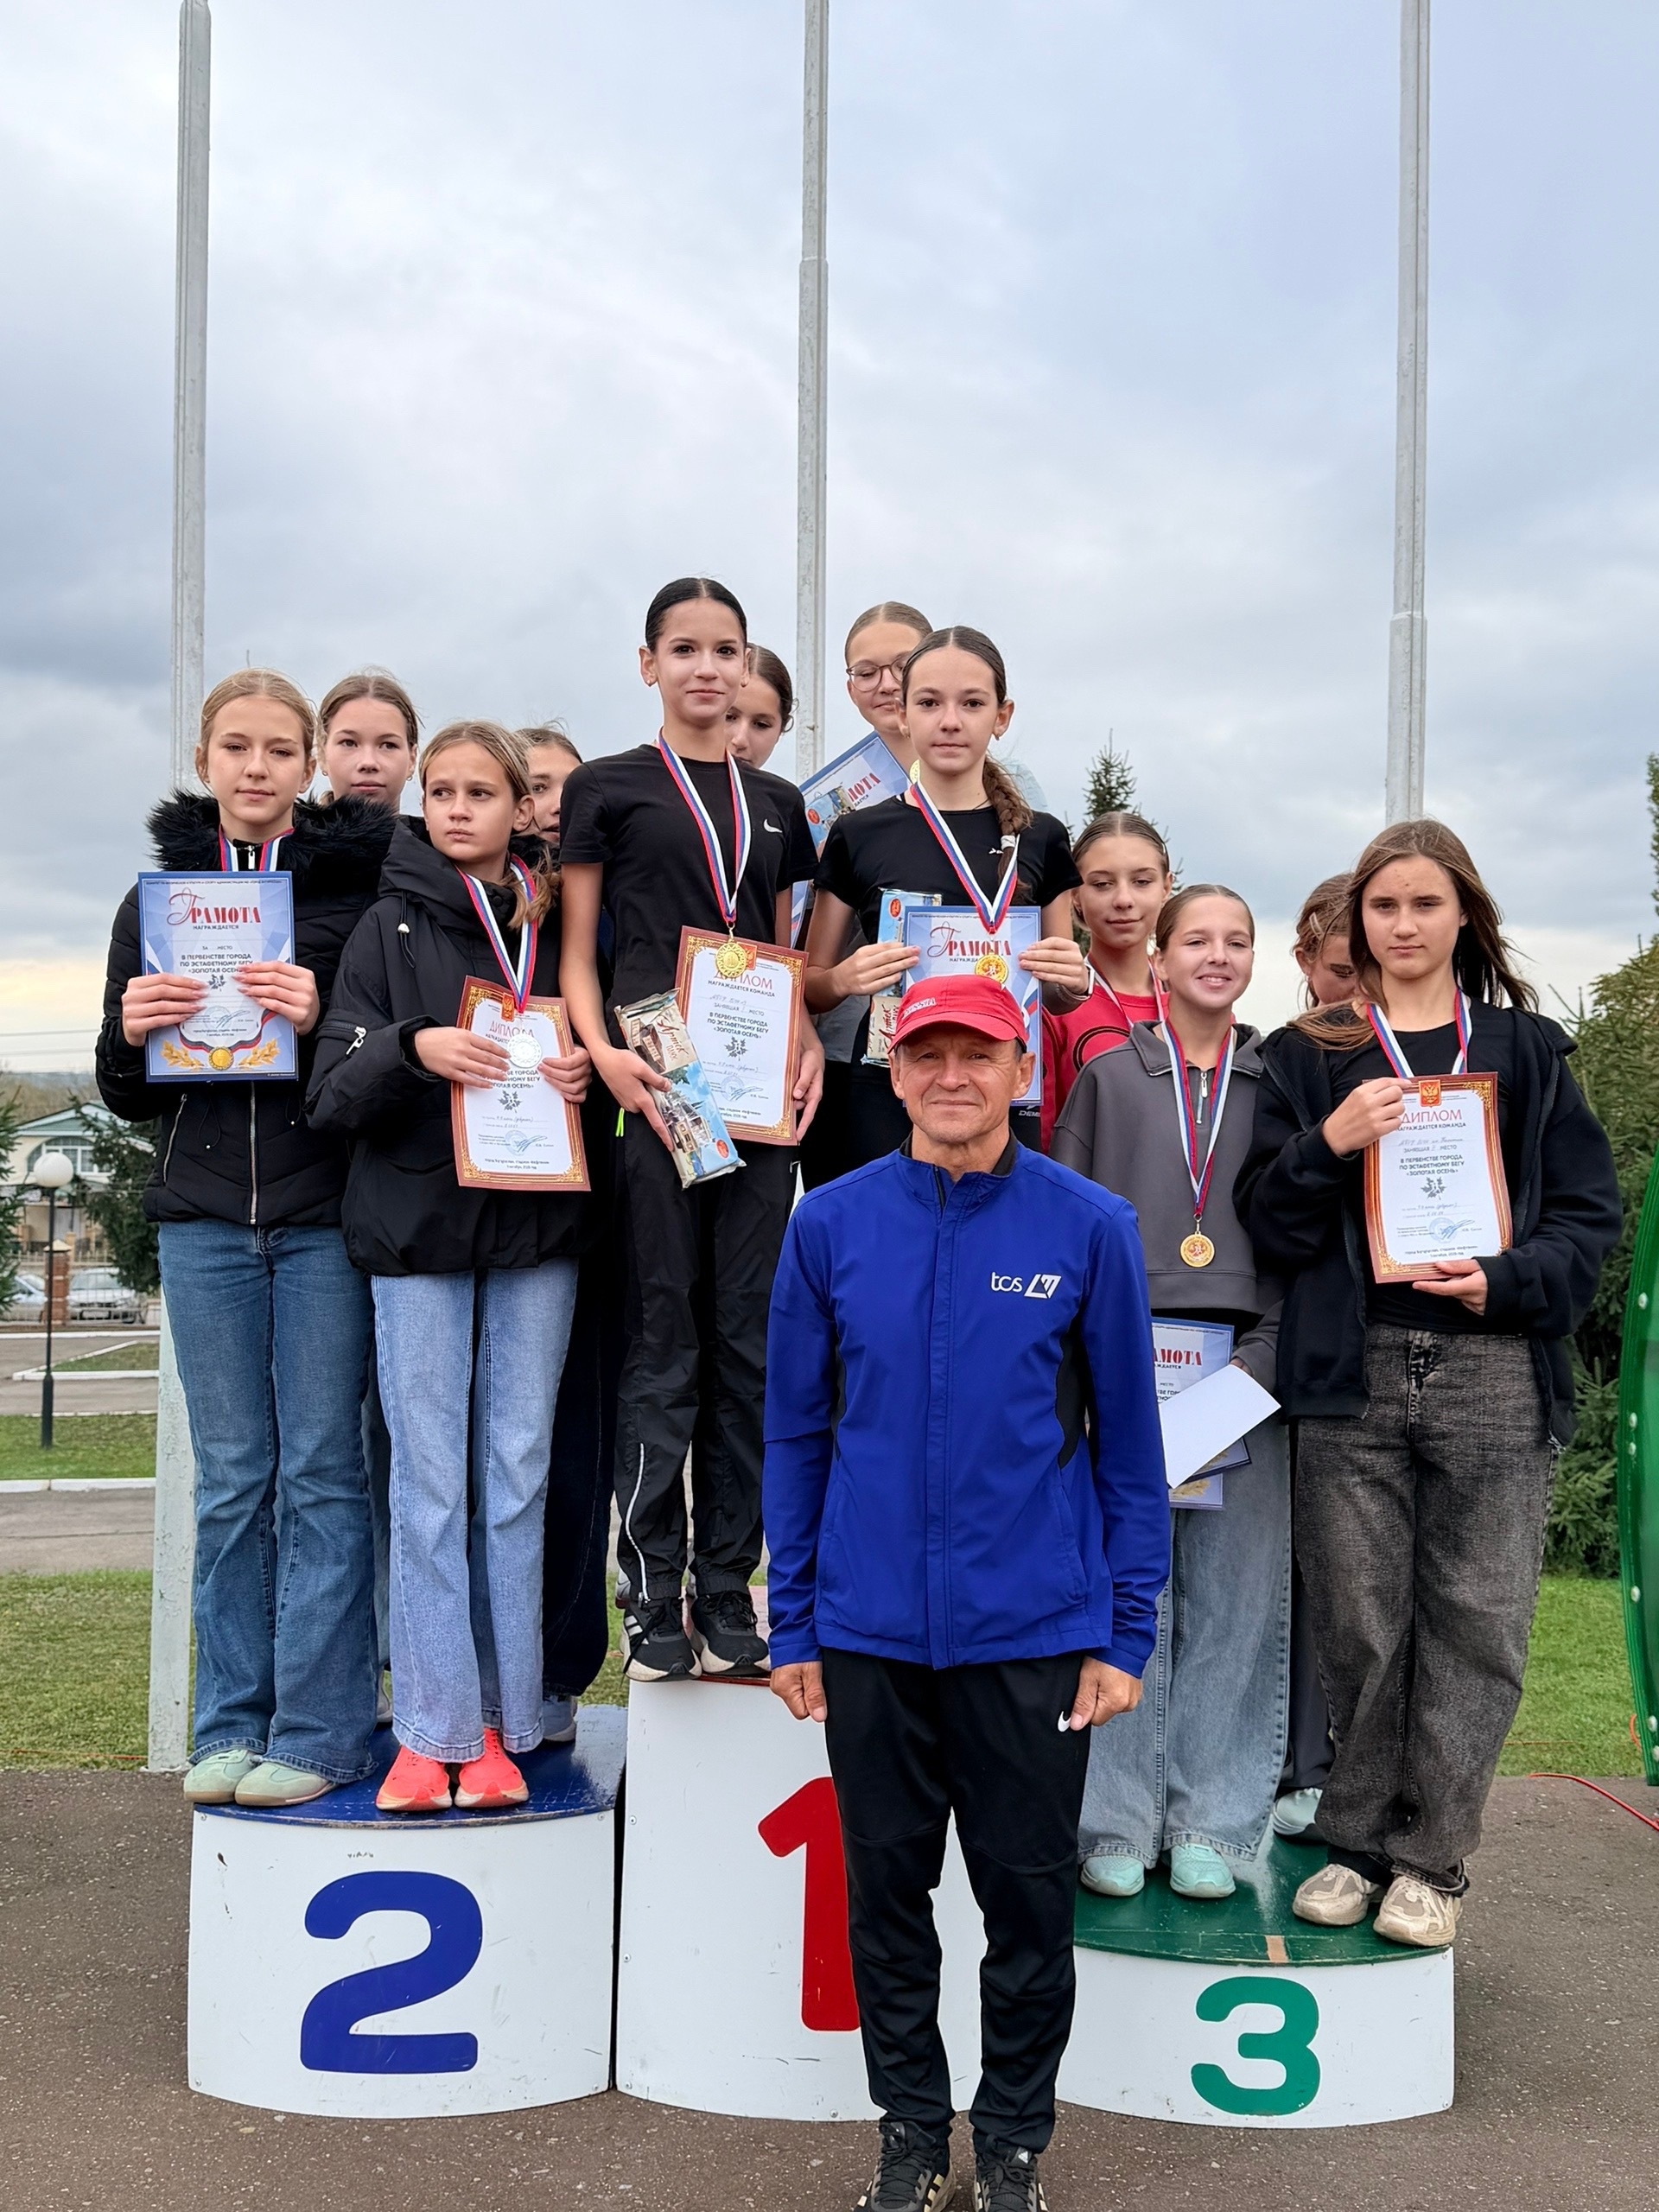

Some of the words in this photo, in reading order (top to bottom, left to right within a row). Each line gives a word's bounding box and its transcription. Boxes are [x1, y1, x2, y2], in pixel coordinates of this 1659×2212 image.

[848, 772, 880, 802] МОТА
[167, 887, 262, 926] ГРАМОТА
[927, 921, 1012, 958] ГРАМОТА
[708, 980, 749, 992] НАГРАЖДАЕТСЯ
[749, 988, 775, 997] КОМАНДА
[714, 1012, 747, 1023] ПЕРВЕНСТВЕ
[747, 1018, 768, 1027] ГОРОДА
[717, 1020, 756, 1031] ЭСТАФЕТНОМУ
[1401, 1109, 1462, 1124] ДИПЛОМ
[1405, 1155, 1439, 1164] ПЕРВЕНСТВЕ
[990, 1271, 1023, 1293] tcs
[1154, 1348, 1202, 1366] АМОТА
[759, 1777, 861, 2031] 1
[300, 1871, 483, 2074] 2
[1191, 1975, 1320, 2115] 3
